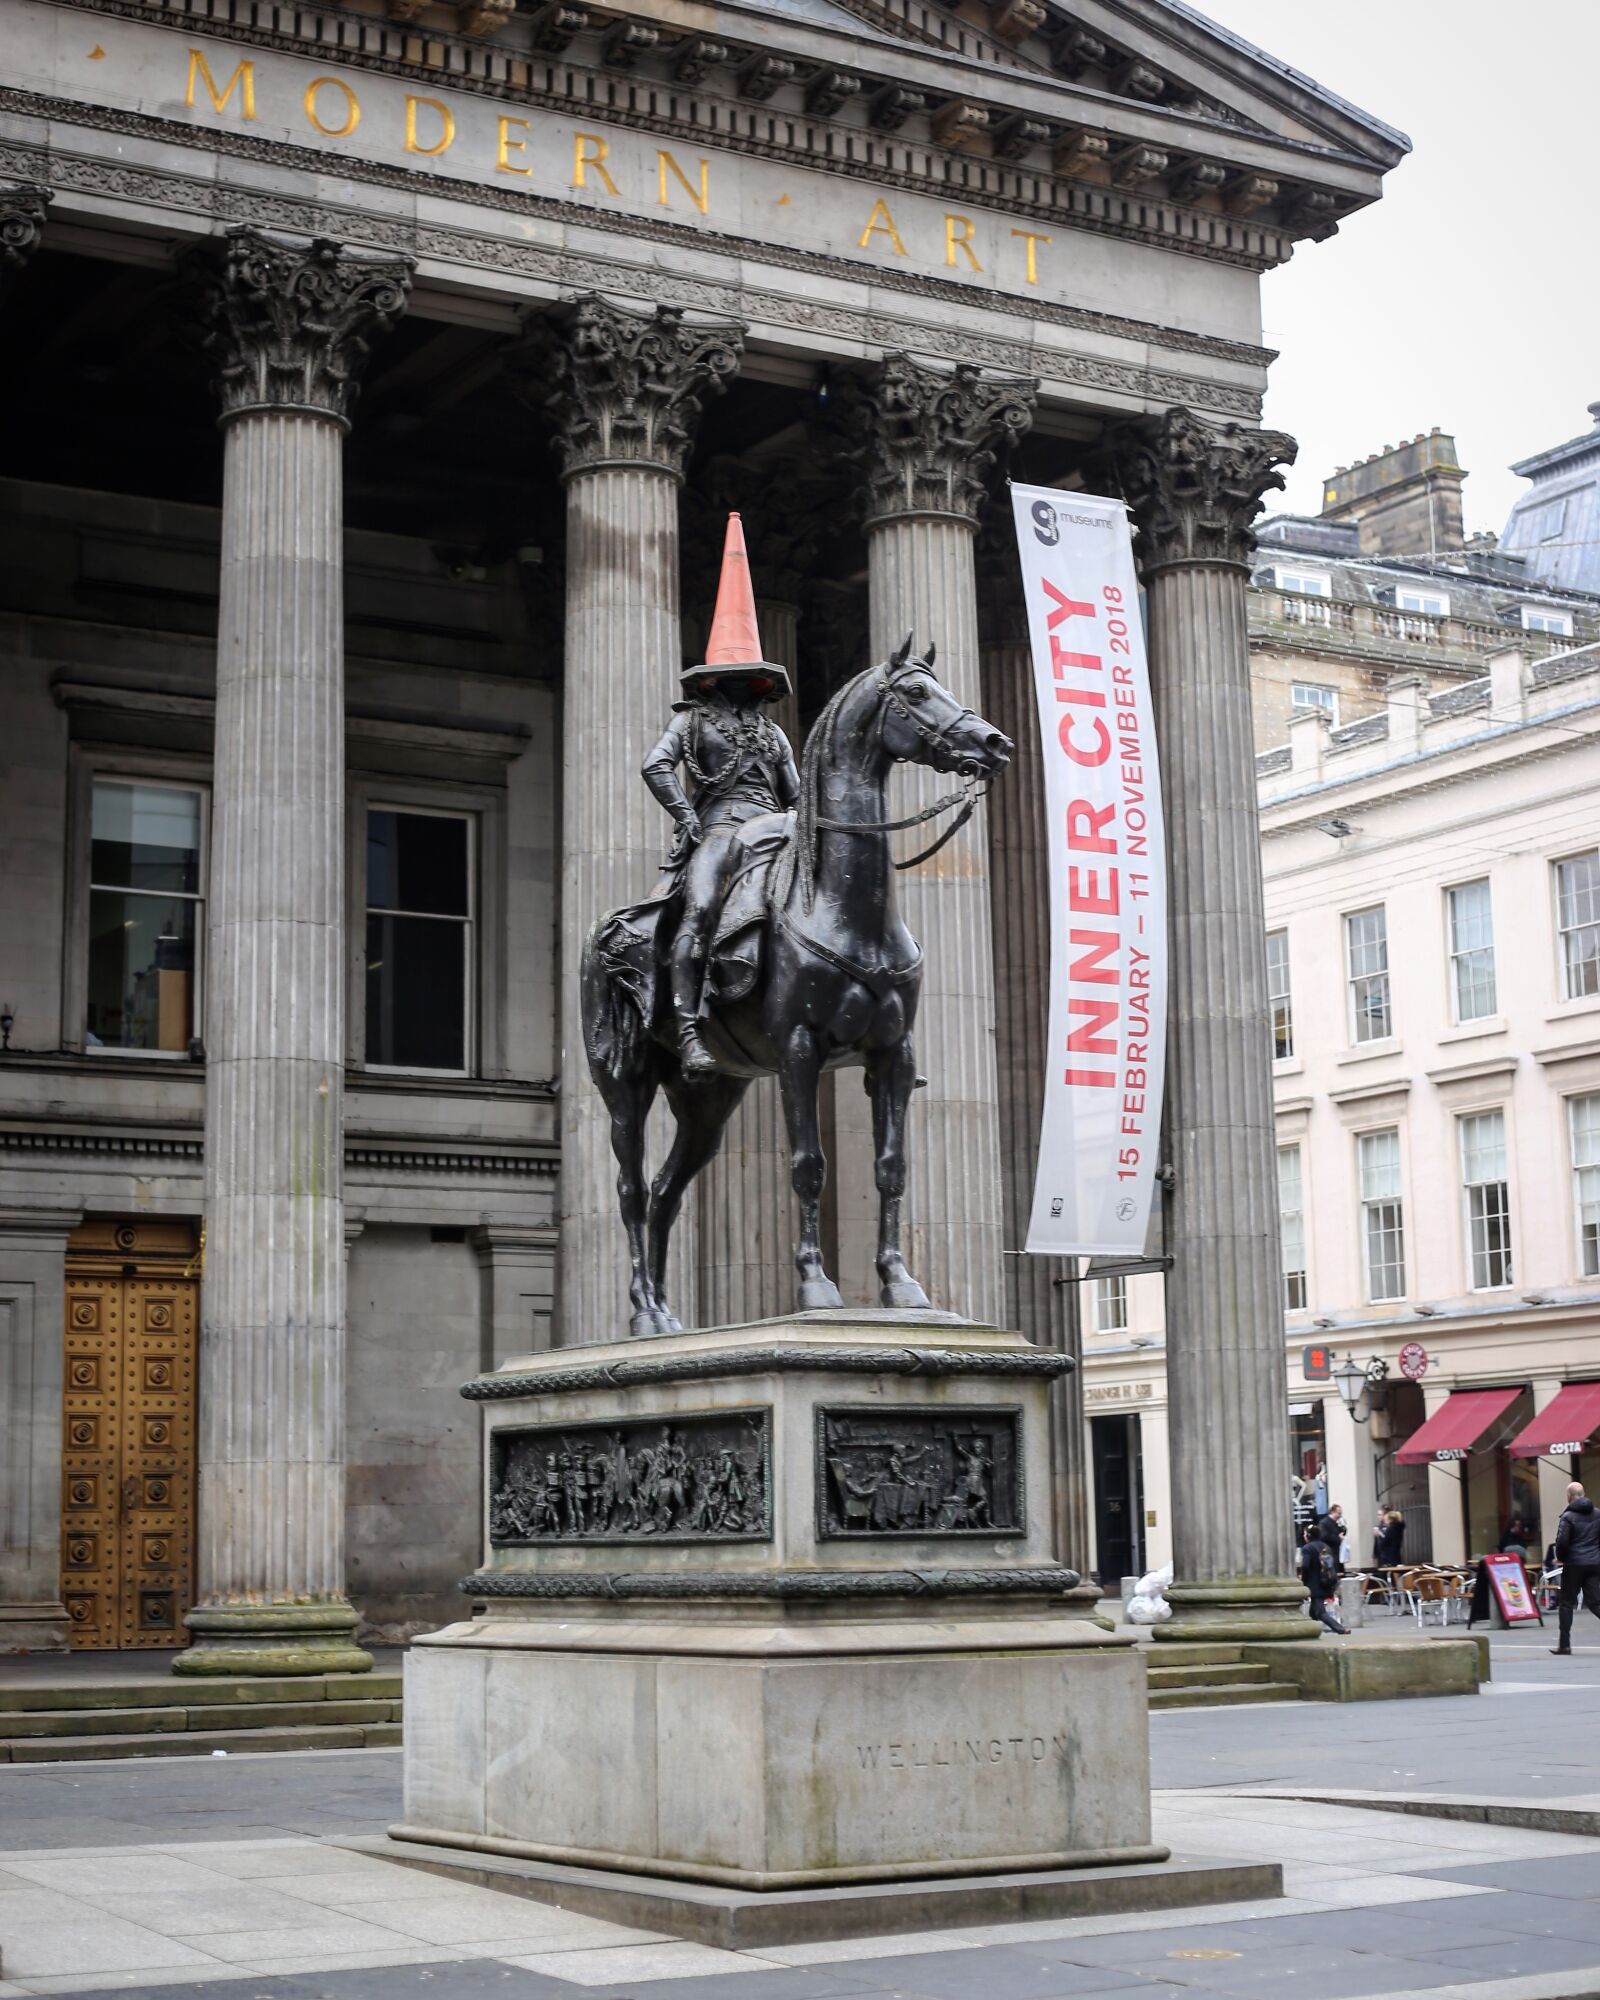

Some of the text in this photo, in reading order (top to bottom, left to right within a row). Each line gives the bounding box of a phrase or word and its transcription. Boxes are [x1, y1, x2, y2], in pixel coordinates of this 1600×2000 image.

[184, 48, 1053, 286] MODERN ART
[1060, 512, 1114, 530] museums
[1103, 585, 1130, 655] 2018
[1112, 665, 1148, 856] NOVEMBER
[1041, 576, 1120, 1089] INNER CITY
[1129, 873, 1149, 901] 11
[1121, 946, 1150, 1135] FEBRUARY
[1117, 1148, 1140, 1182] 15
[1436, 1449, 1468, 1460] COSTA
[1549, 1442, 1582, 1454] COSTA
[857, 1733, 1071, 1769] WELLINGTON
